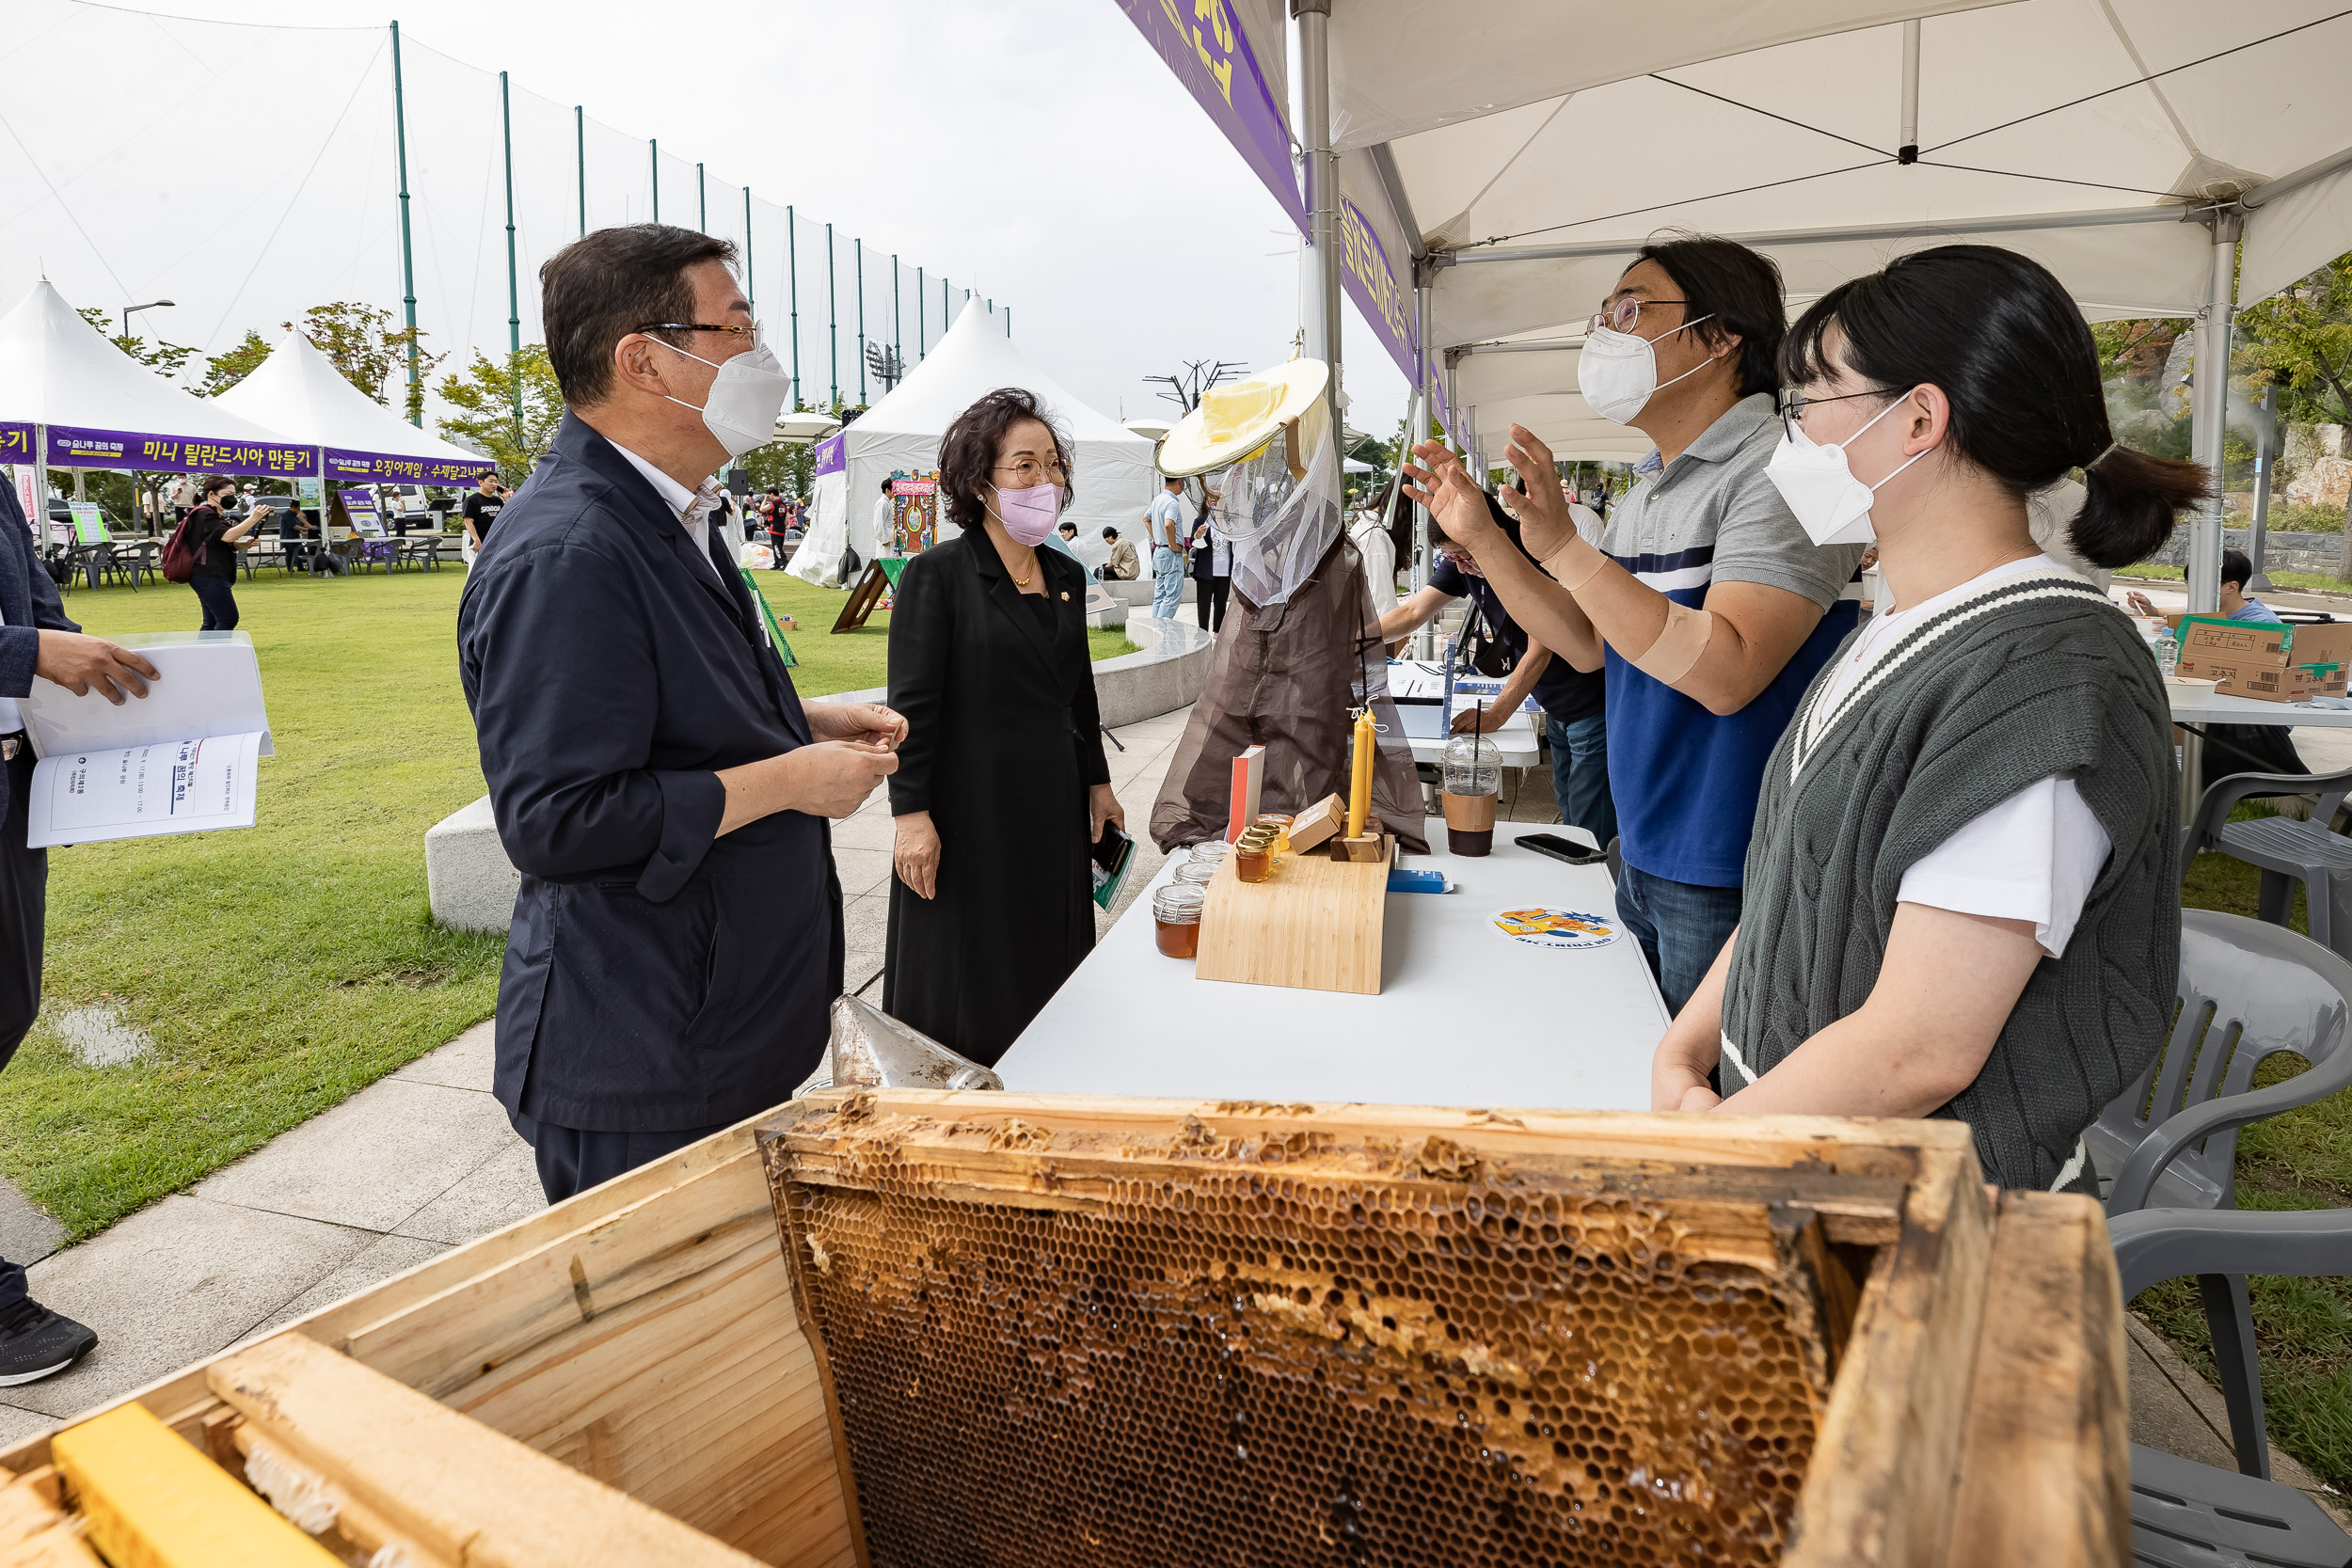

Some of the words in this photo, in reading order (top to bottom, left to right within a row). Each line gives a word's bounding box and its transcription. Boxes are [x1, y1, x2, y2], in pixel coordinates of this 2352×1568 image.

[72, 439, 93, 449] 숲나루
[95, 441, 109, 451] 꿈의
[143, 441, 178, 461] 미니
[184, 444, 263, 467] 틸란드시아
[268, 450, 310, 470] 만들기
[373, 459, 422, 479] 오징어게임
[2209, 670, 2236, 680] 고추지
[77, 768, 87, 795] 구의제2동
[176, 765, 187, 781] 꿈의
[175, 784, 186, 801] 축제
